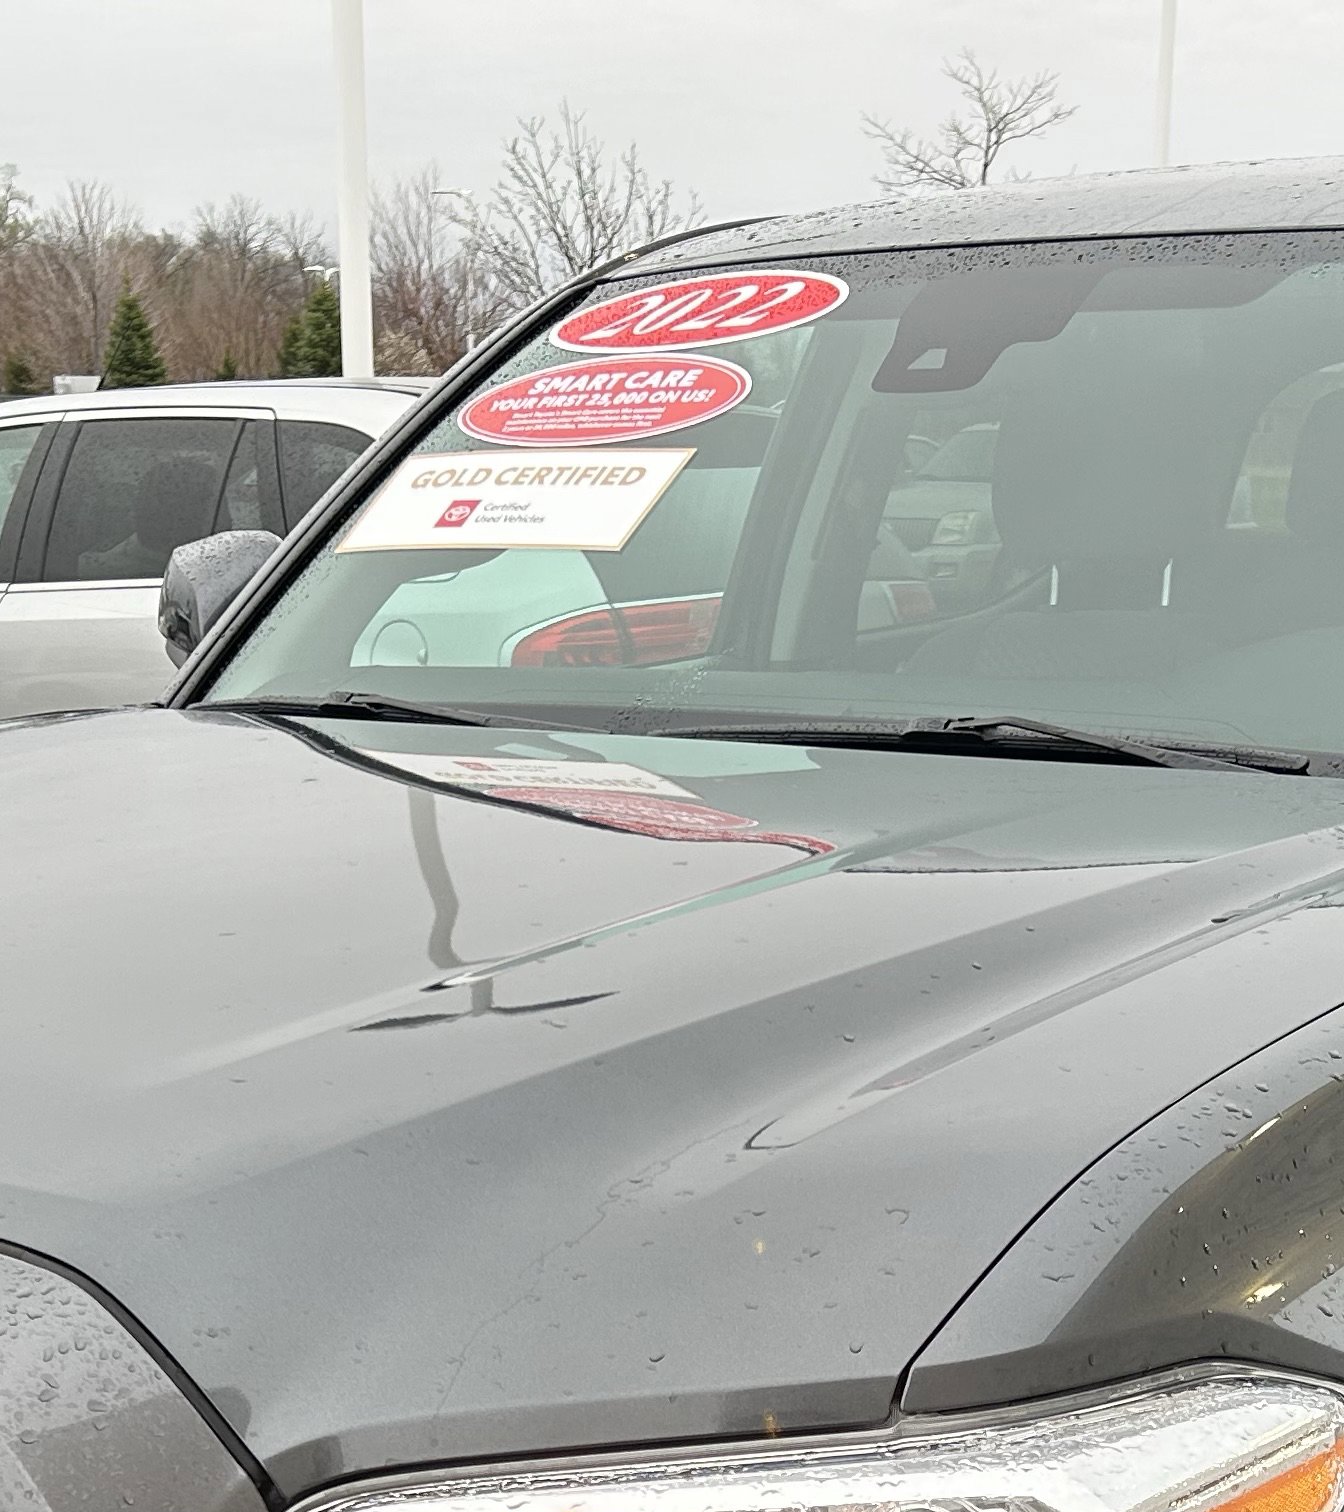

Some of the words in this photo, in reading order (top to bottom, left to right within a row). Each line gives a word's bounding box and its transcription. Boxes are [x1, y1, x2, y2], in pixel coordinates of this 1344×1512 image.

[578, 281, 806, 341] 2022
[528, 371, 628, 395] SMART
[624, 369, 704, 389] CARE
[489, 397, 538, 412] YOUR
[537, 394, 588, 409] FIRST
[586, 391, 650, 406] 25,000
[649, 391, 681, 404] ON
[679, 389, 716, 403] US!
[411, 467, 493, 489] GOLD
[494, 466, 647, 487] CERTIFIED
[483, 502, 531, 512] Certified
[475, 514, 501, 524] Used
[503, 514, 545, 524] Vehicles
